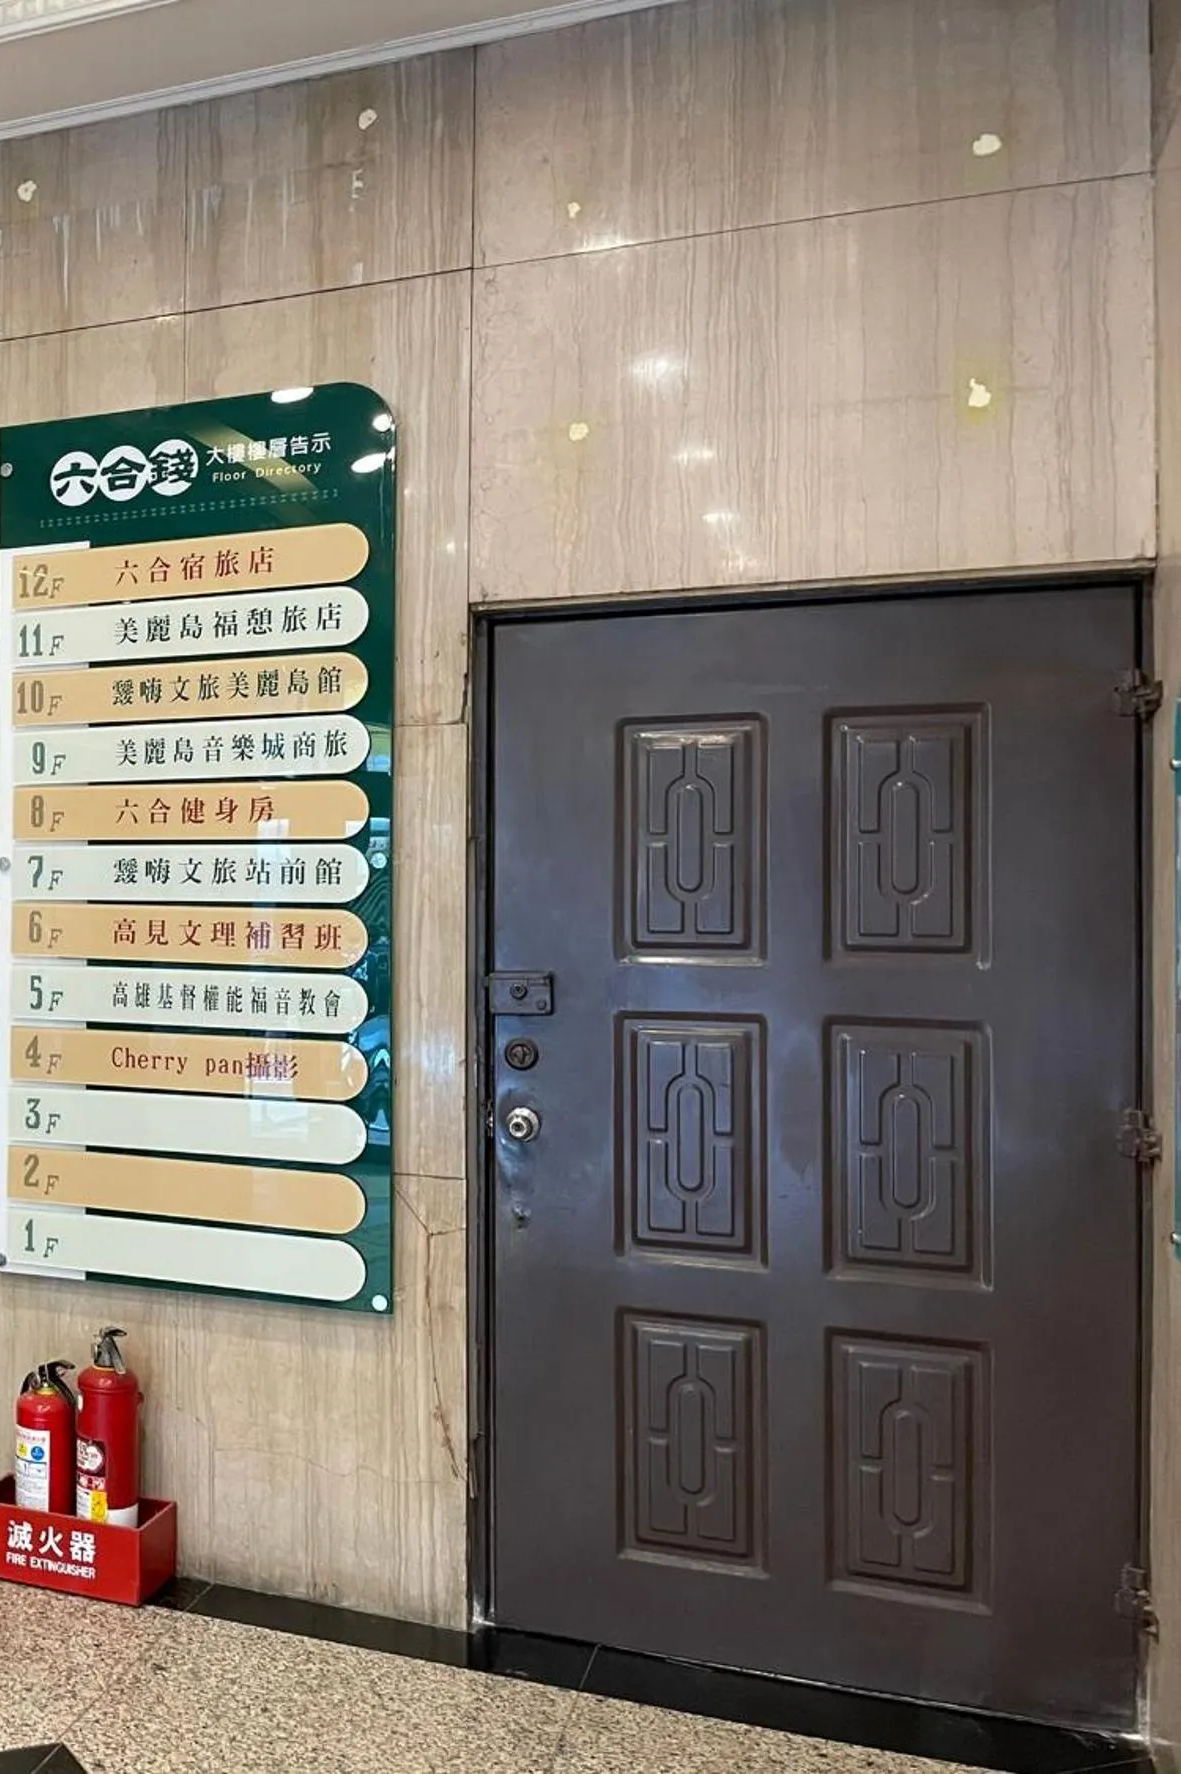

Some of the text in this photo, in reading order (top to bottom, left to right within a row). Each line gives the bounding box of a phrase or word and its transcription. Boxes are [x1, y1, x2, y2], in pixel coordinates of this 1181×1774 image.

[52, 444, 196, 501] 六合錢
[212, 462, 322, 483] Floor Directory
[18, 546, 275, 600] 12F 六合宿旅店
[18, 602, 343, 657] 11F 美麗島福憩旅店
[17, 680, 63, 717] 10F
[31, 729, 348, 775] 9F 美麗島音樂城商旅
[30, 795, 275, 832] 8F 六合健身房
[27, 855, 64, 891] 7F
[28, 910, 342, 950] 6F 高見文理補習班
[29, 975, 342, 1018] 5F 高雄基督權能福音教會
[25, 1035, 62, 1075] 4F
[111, 1047, 189, 1075] Cherry
[24, 1098, 61, 1134] 3F
[23, 1154, 60, 1196] 2F
[23, 1218, 59, 1258] 1F
[7, 1519, 96, 1564] 滅火器
[6, 1551, 97, 1579] FIRE EXTINGUISHER
